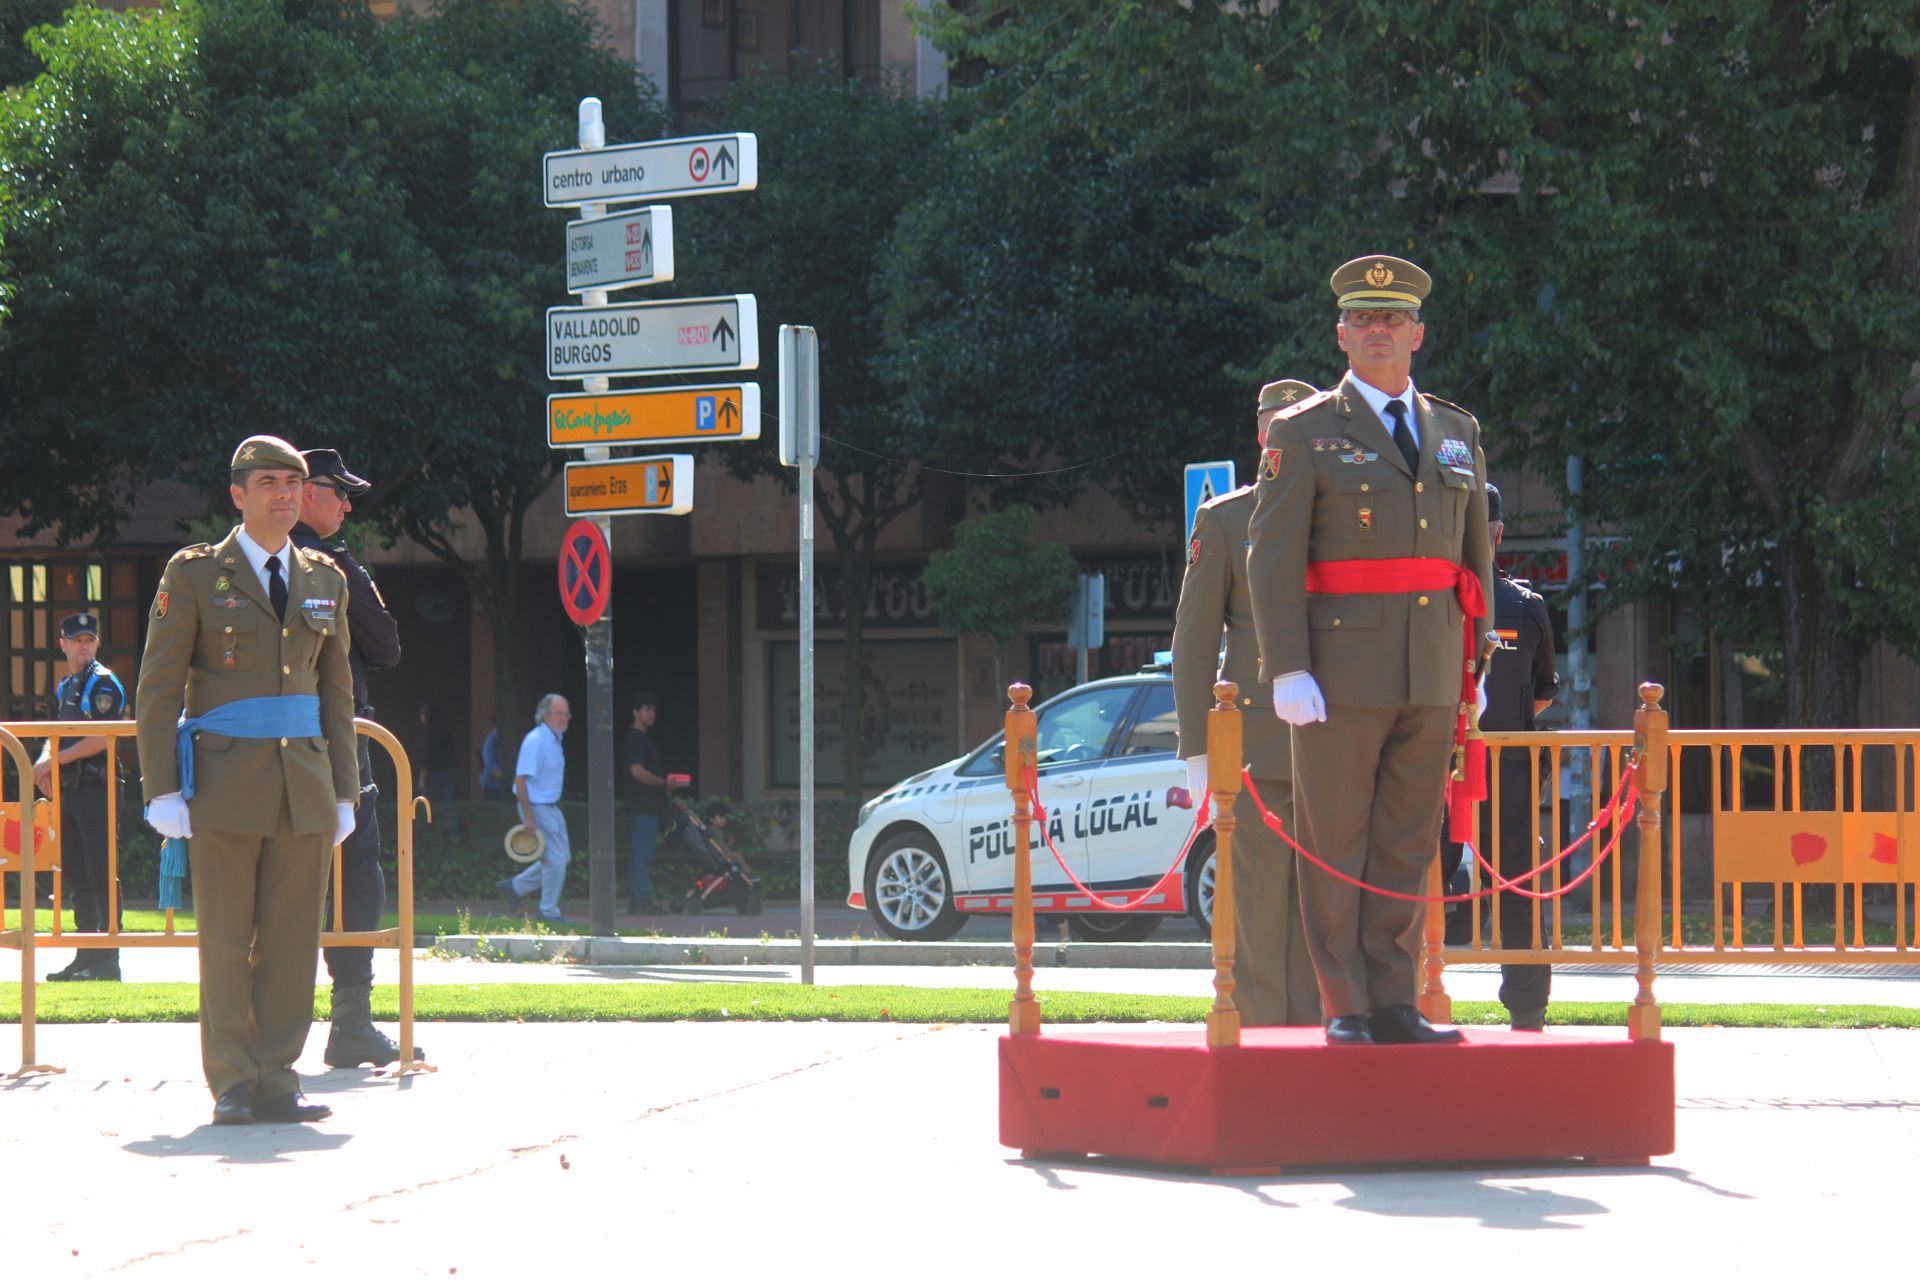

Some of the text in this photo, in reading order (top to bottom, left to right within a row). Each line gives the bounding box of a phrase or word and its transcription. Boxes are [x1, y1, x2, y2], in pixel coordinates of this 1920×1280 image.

[553, 164, 645, 189] centro urbano
[571, 235, 594, 252] ASTORGA
[570, 259, 598, 276] BENAVENTE
[554, 317, 641, 340] VALLADOLID
[679, 326, 709, 345] N-601
[554, 343, 612, 365] BURGOS
[566, 408, 592, 430] Corte
[699, 401, 713, 427] P
[570, 482, 607, 498] aparcamiento
[610, 475, 628, 495] Eras
[1074, 790, 1158, 839] LOCAL
